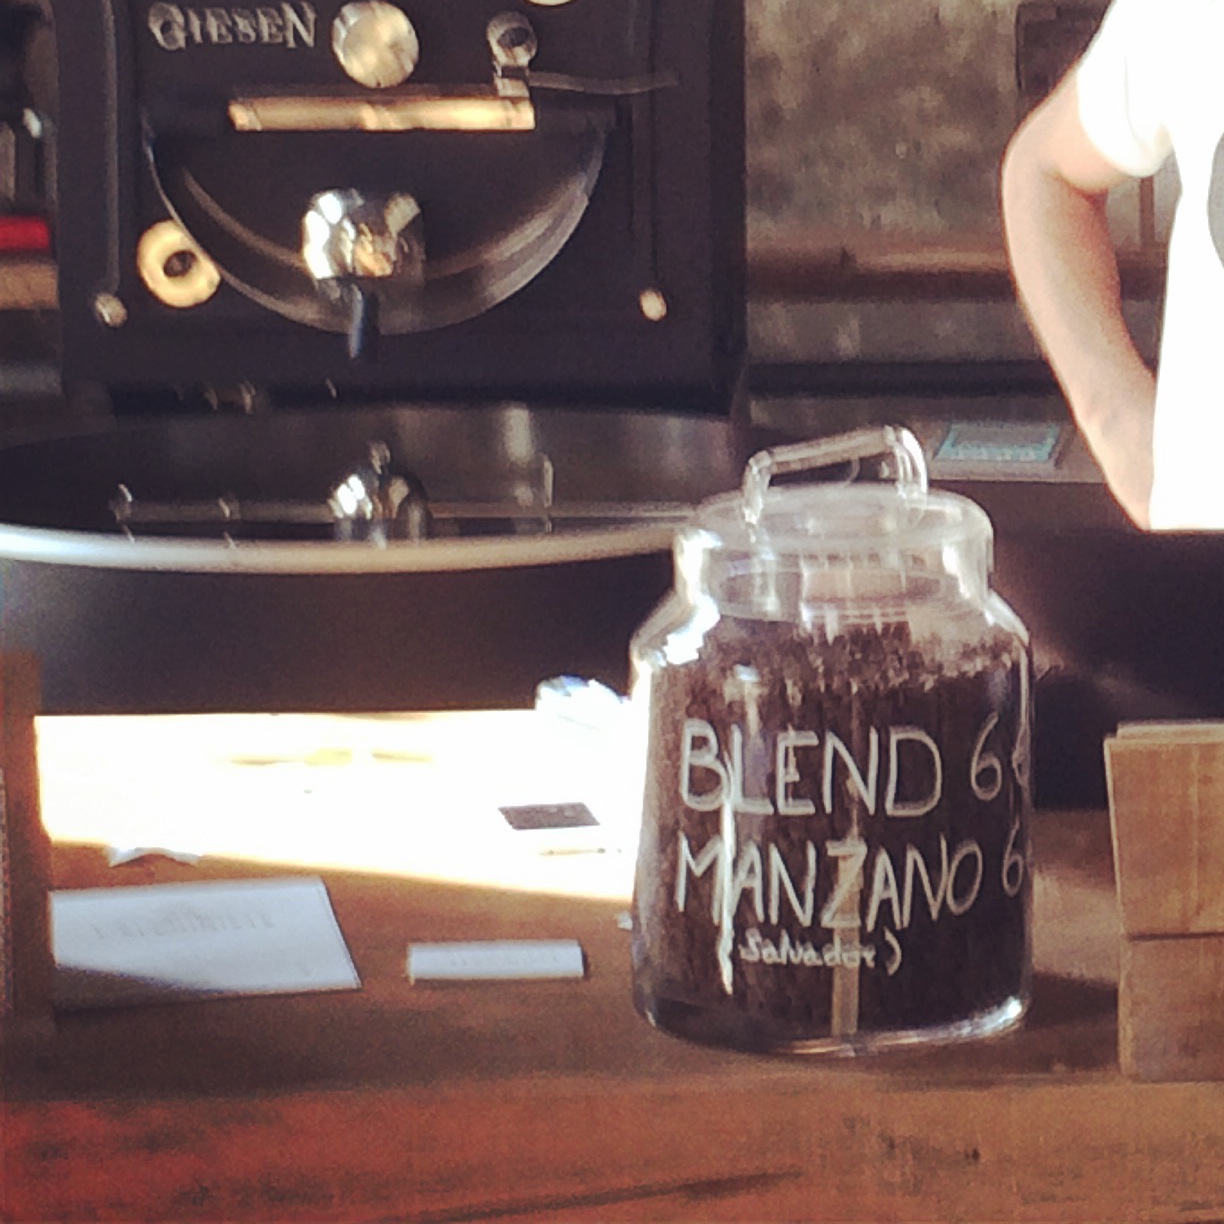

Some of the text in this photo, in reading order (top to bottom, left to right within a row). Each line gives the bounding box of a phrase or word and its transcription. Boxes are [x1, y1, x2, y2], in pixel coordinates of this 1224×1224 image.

[148, 1, 316, 51] GIESEN
[680, 718, 943, 817] BLEND
[675, 828, 983, 932] MANZANO
